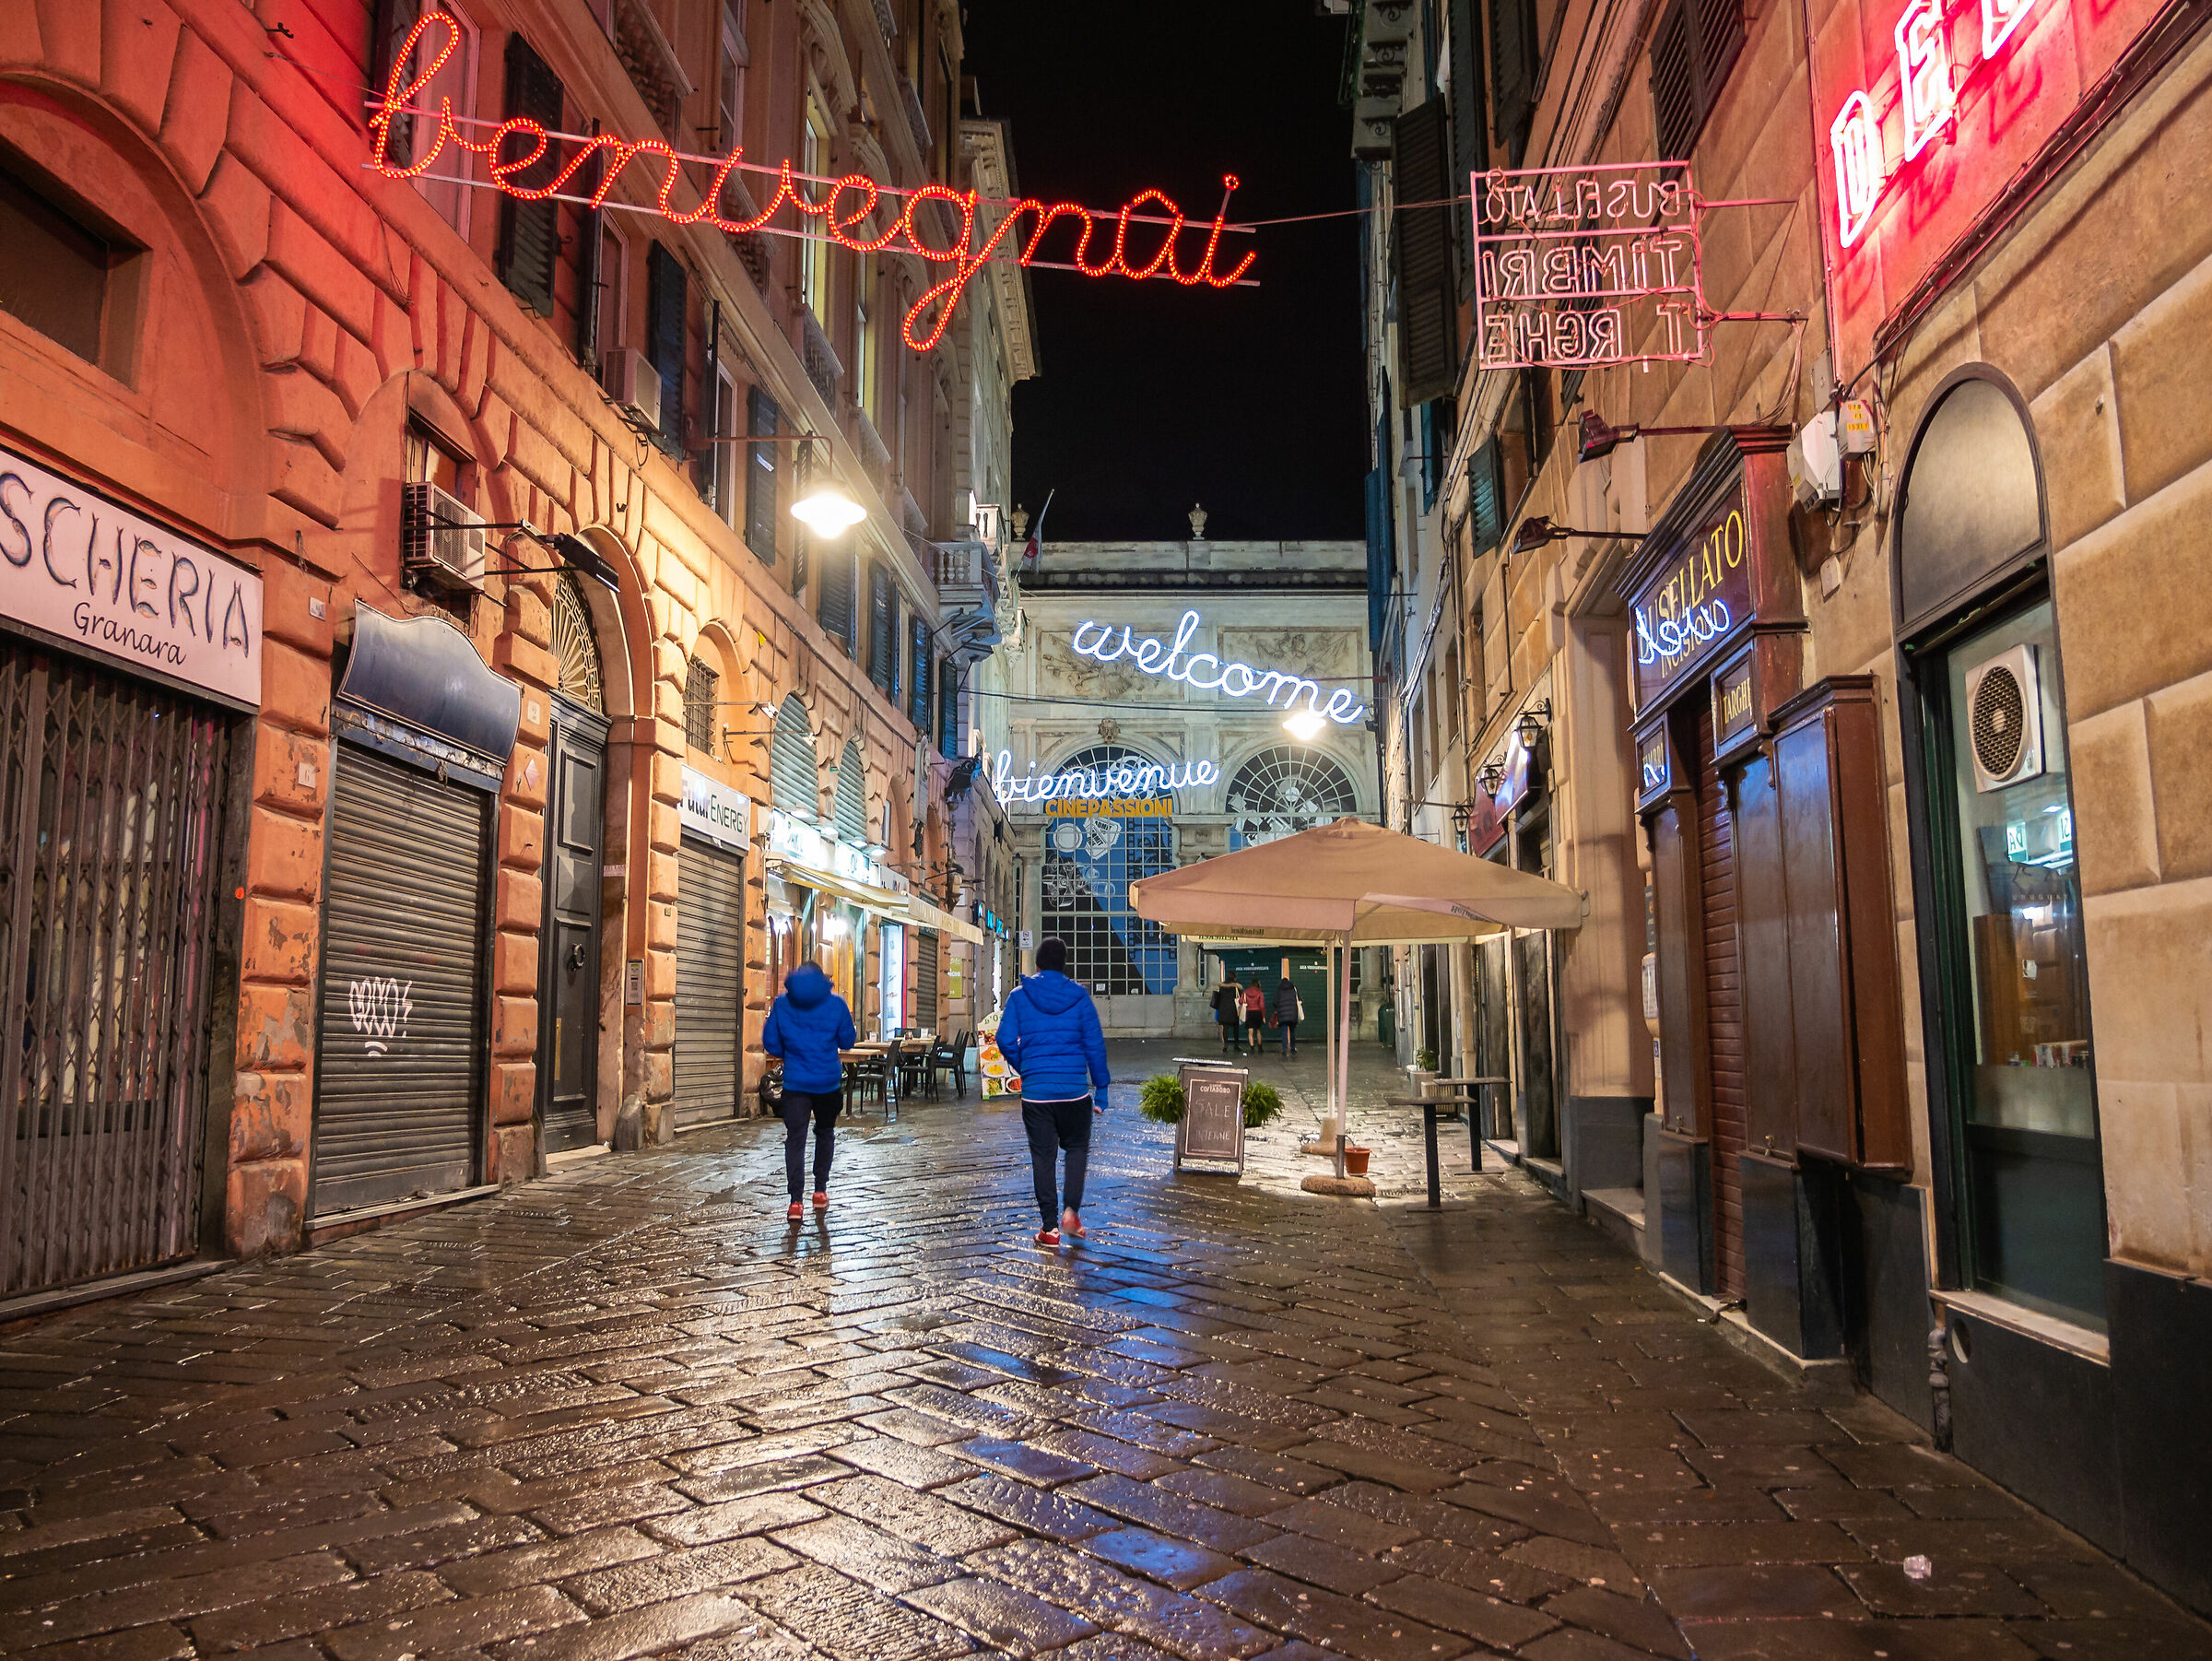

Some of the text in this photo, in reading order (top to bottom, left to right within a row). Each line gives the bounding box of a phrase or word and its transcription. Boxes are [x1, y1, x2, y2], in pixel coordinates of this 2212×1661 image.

[73, 601, 187, 666] Granara
[1072, 609, 1364, 724] welcome
[994, 749, 1219, 805] bienvenue
[1045, 798, 1173, 818] CINEPASSIONI
